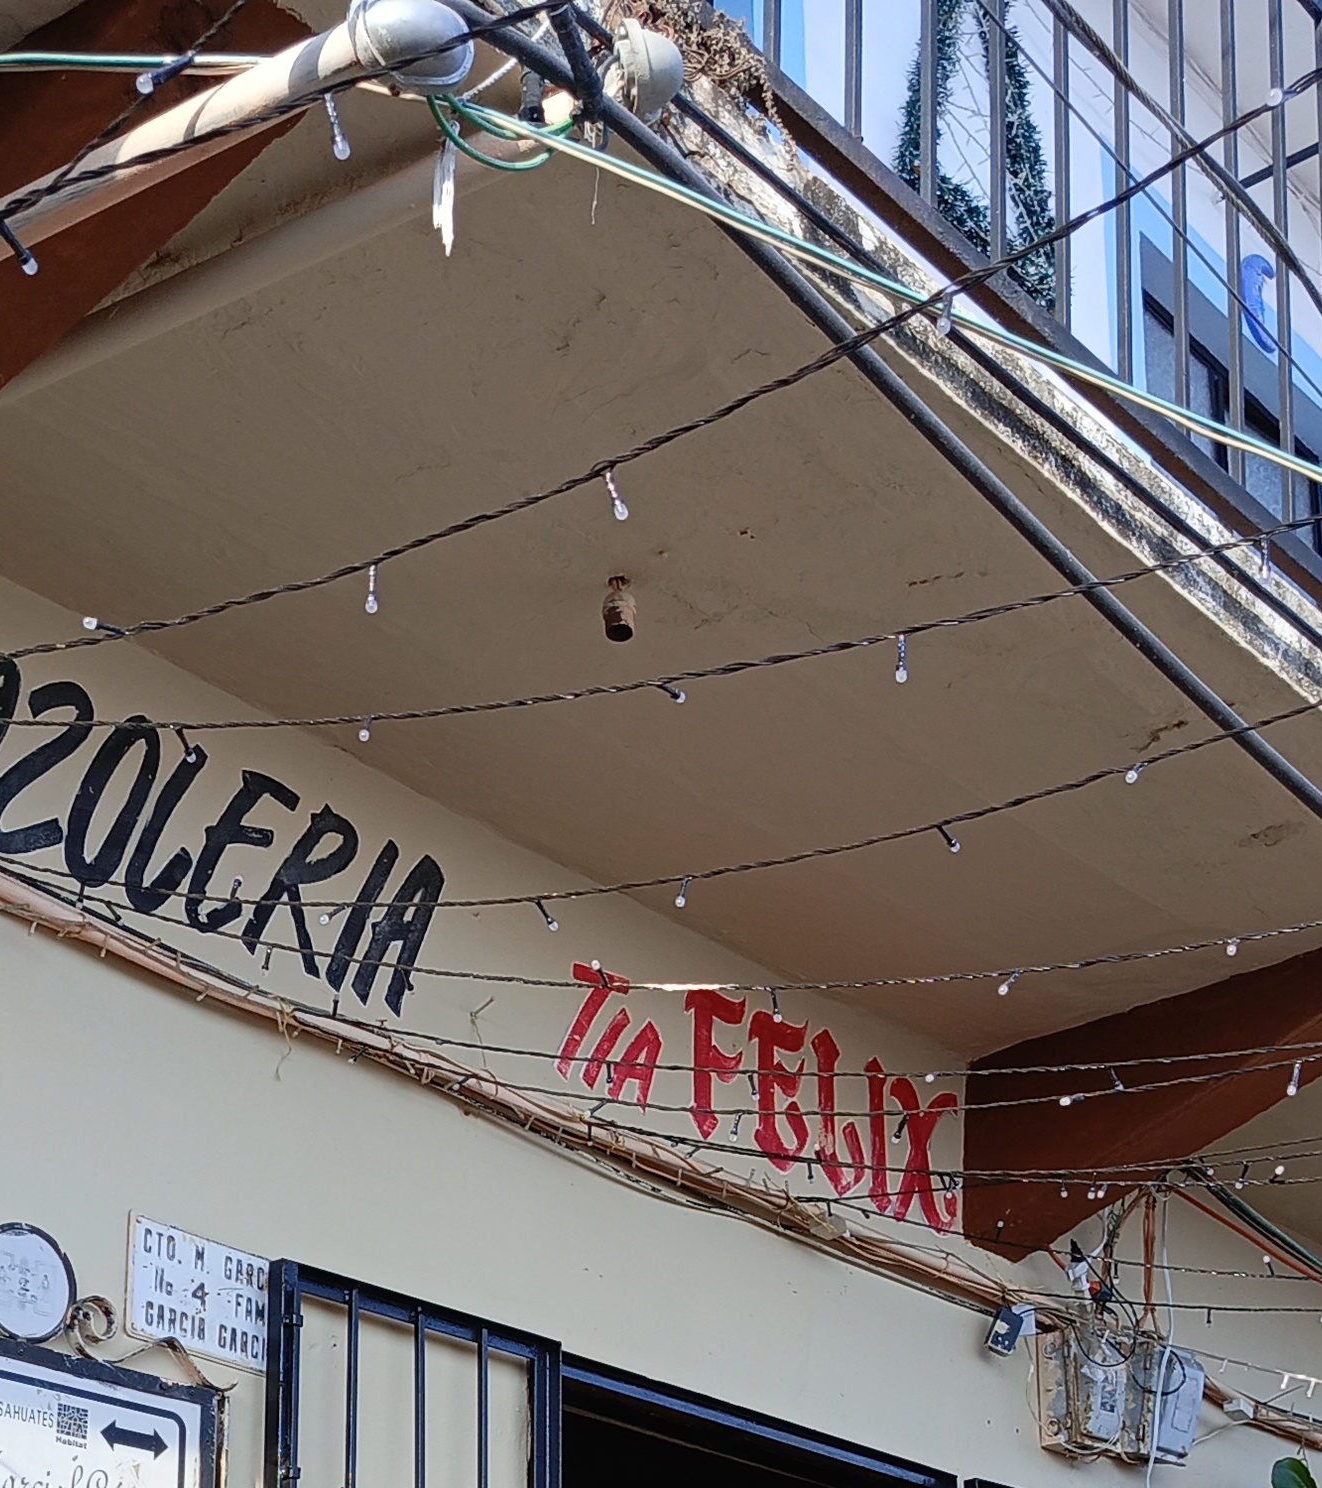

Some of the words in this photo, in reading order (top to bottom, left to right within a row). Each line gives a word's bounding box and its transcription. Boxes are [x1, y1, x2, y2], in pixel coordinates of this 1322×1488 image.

[684, 988, 960, 1236] FELIX
[143, 1227, 182, 1265] CTO.
[194, 1245, 210, 1275] M.
[223, 1254, 265, 1291] GARC
[191, 1282, 210, 1313] 4
[144, 1300, 206, 1342] GARCIA
[217, 1323, 266, 1362] GARCI
[55, 1436, 88, 1450] Habitat
